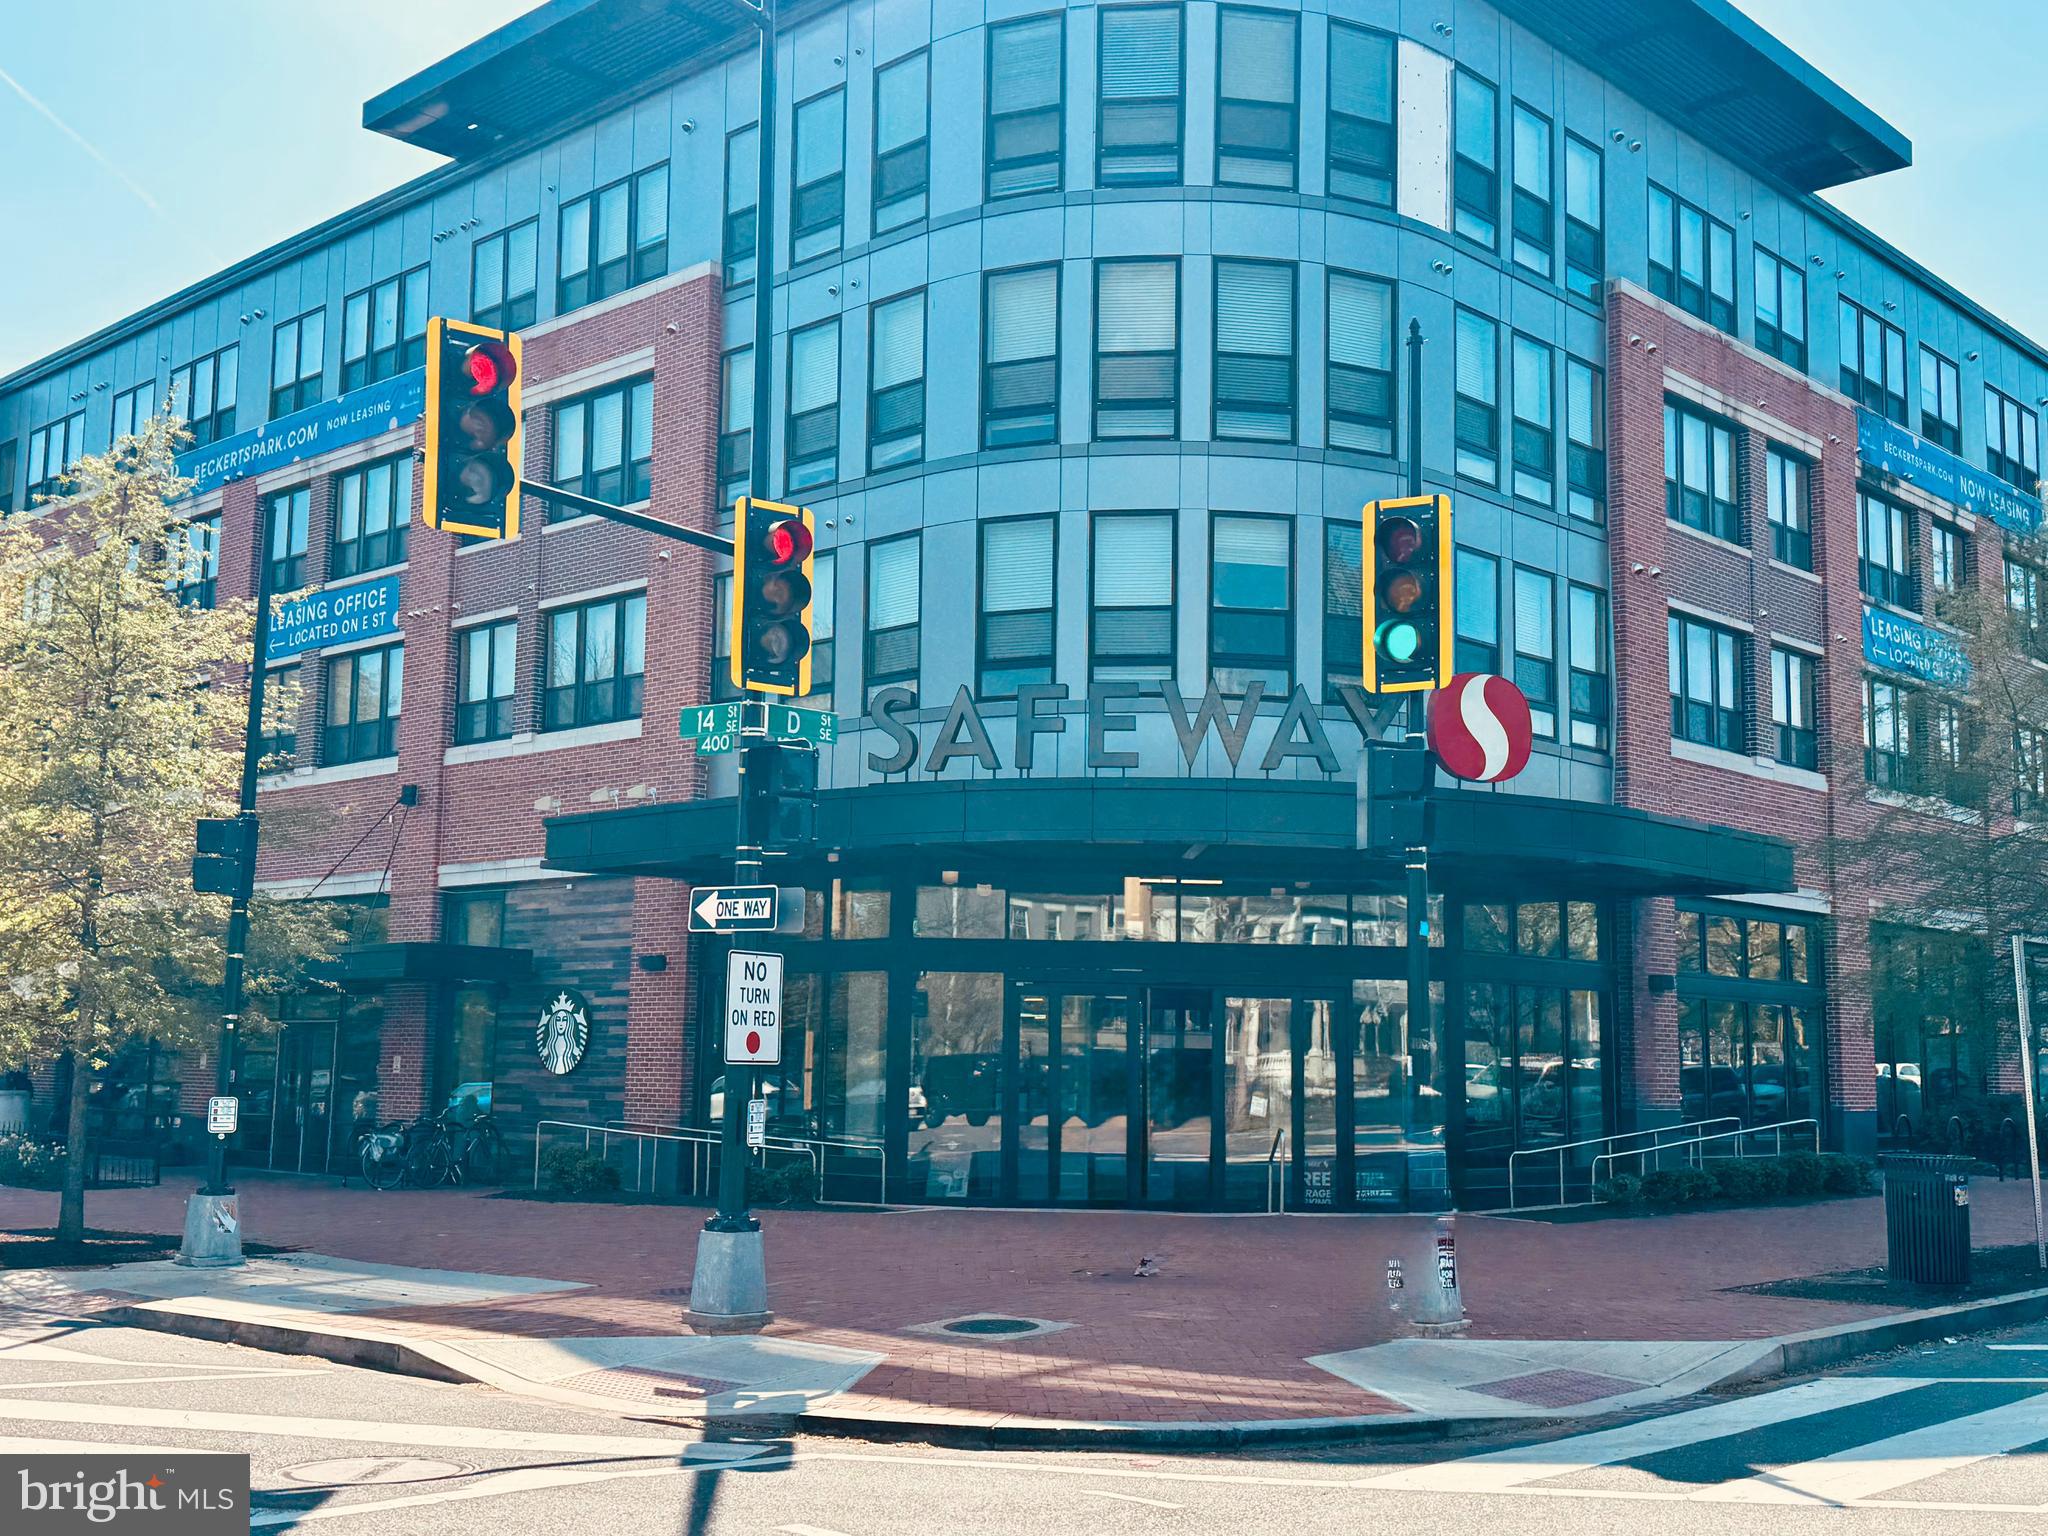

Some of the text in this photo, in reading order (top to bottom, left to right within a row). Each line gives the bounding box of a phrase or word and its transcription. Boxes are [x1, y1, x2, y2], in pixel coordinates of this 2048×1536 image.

[194, 422, 318, 480] BECKERTSPARK.COM
[326, 416, 348, 431] NOW
[351, 400, 391, 424] LEASING
[1884, 441, 2030, 524] BECKERTSPARK.COM NOW LEASING
[270, 587, 387, 633] LEASING OFFICE
[289, 611, 387, 647] LOCATED ON E ST
[1871, 616, 1921, 650] LEASING
[1889, 647, 1930, 672] LOCATED
[697, 705, 738, 733] 14 St SE
[787, 710, 832, 742] D St SE
[868, 680, 1406, 773] SAFEWAY
[701, 735, 730, 753] 400
[716, 900, 768, 917] ONE WAY
[744, 961, 767, 982] NO
[740, 987, 770, 1004] TURN
[731, 1009, 775, 1027] ON RED
